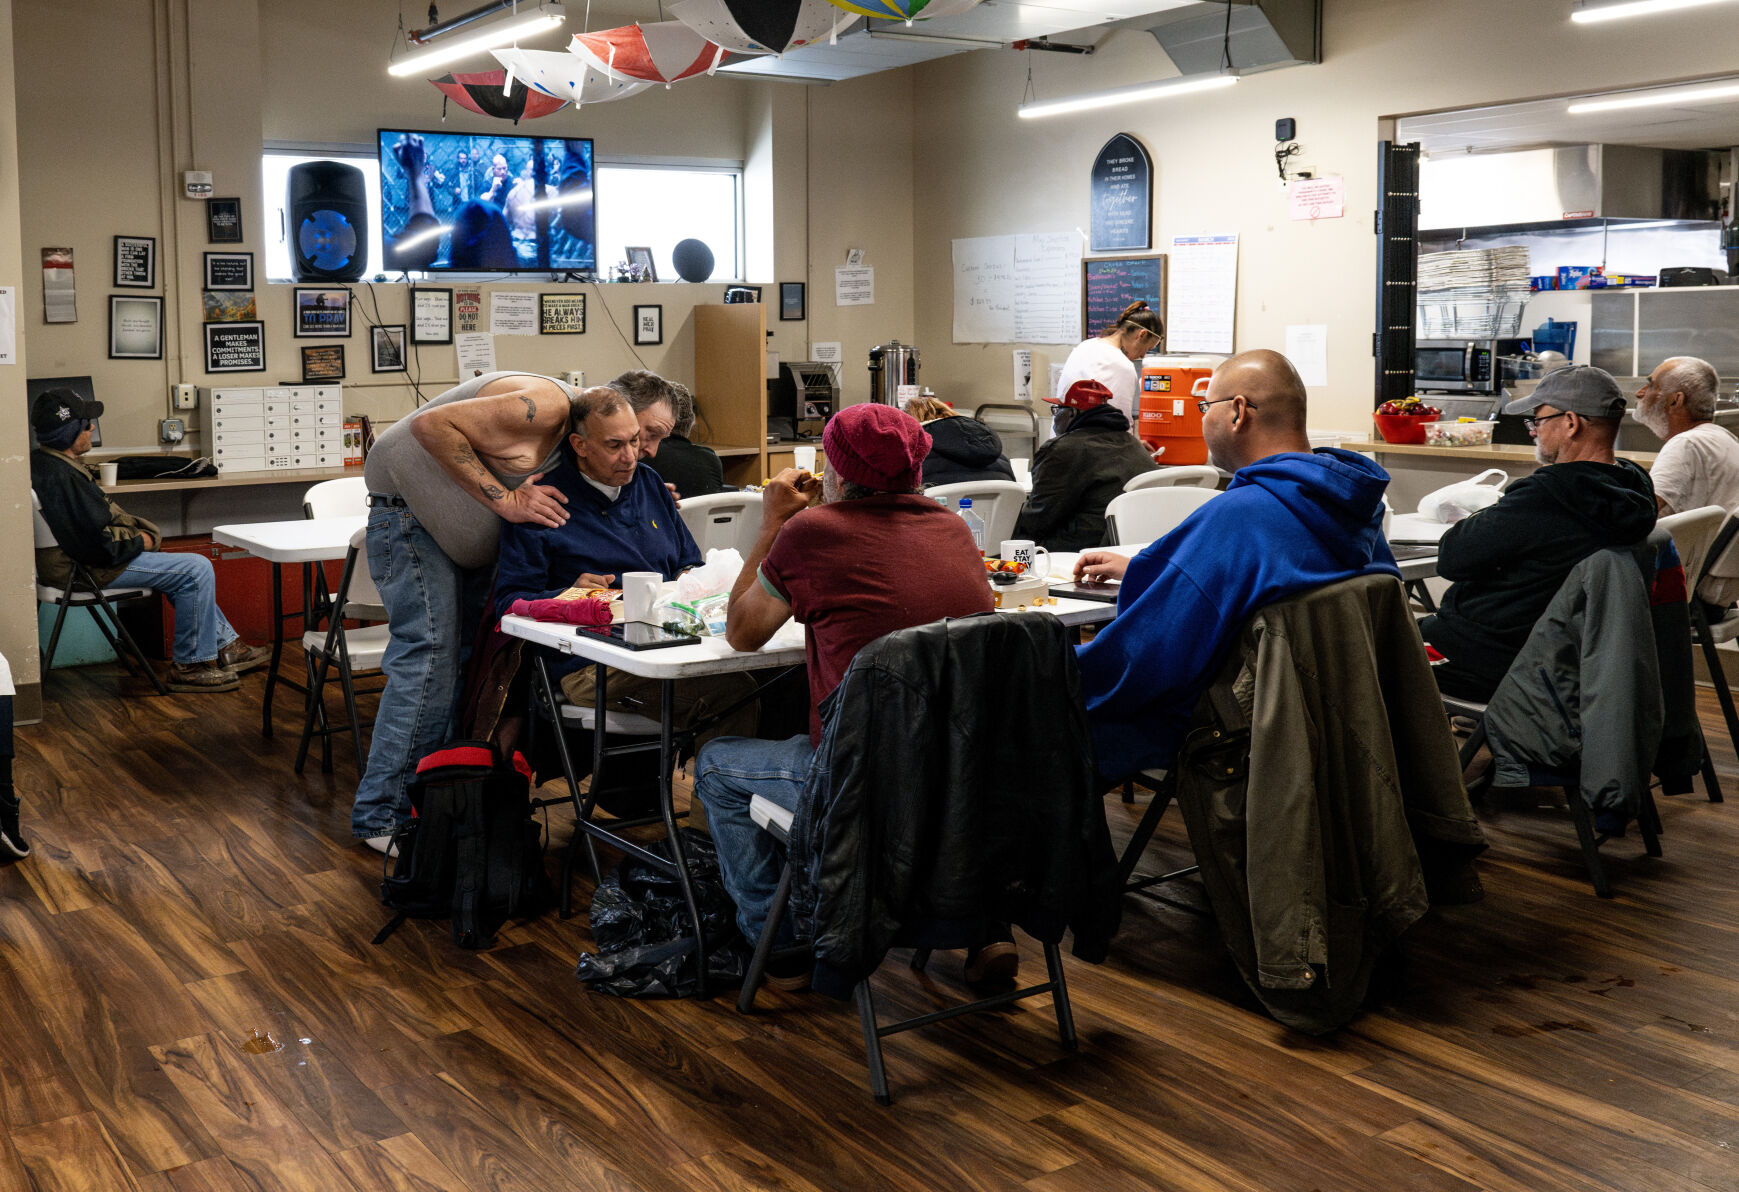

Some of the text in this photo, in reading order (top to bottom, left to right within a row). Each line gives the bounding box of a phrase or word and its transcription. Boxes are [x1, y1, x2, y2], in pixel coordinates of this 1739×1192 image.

[1102, 189, 1138, 210] together
[456, 293, 480, 304] NOTHING
[304, 313, 345, 324] TO PRAY
